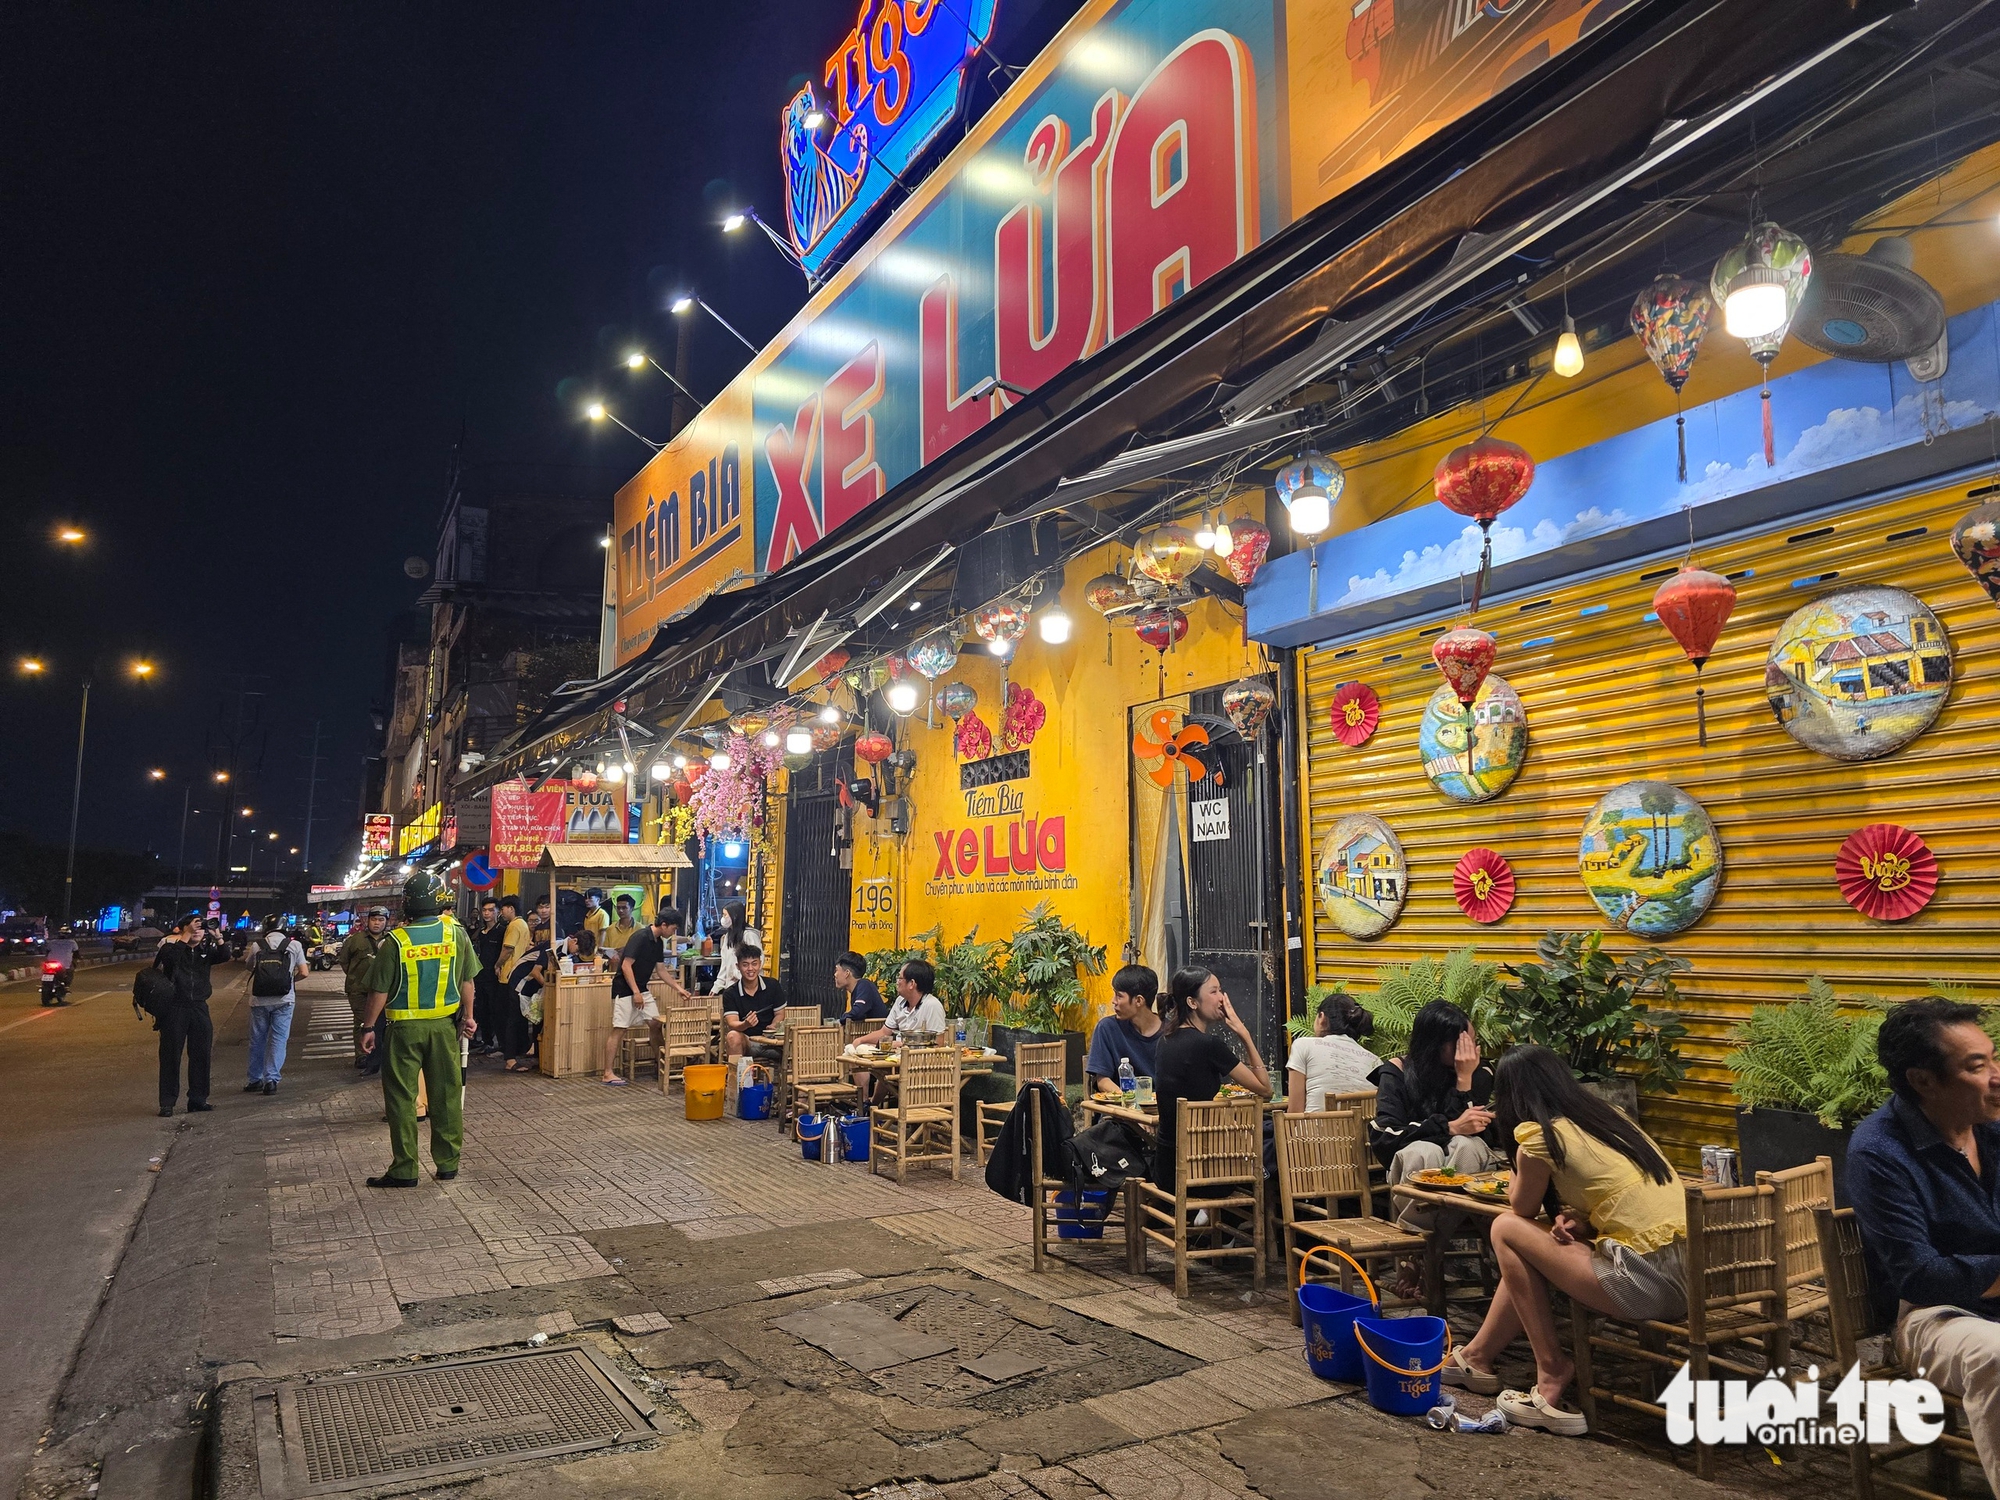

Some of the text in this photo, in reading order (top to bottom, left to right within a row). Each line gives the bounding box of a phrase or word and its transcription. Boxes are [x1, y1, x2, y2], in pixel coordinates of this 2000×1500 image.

[763, 28, 1260, 574] XE LỬA
[689, 440, 741, 552] BIA
[546, 784, 564, 792] VIÊN
[997, 784, 1024, 815] Bia
[1199, 802, 1222, 817] WC
[1197, 821, 1227, 837] NAM
[986, 878, 995, 893] và
[996, 877, 1009, 892] các
[1061, 873, 1078, 890] dân
[855, 885, 892, 913] 196
[1308, 1342, 1335, 1362] Tiger
[1398, 1380, 1432, 1398] Tiger
